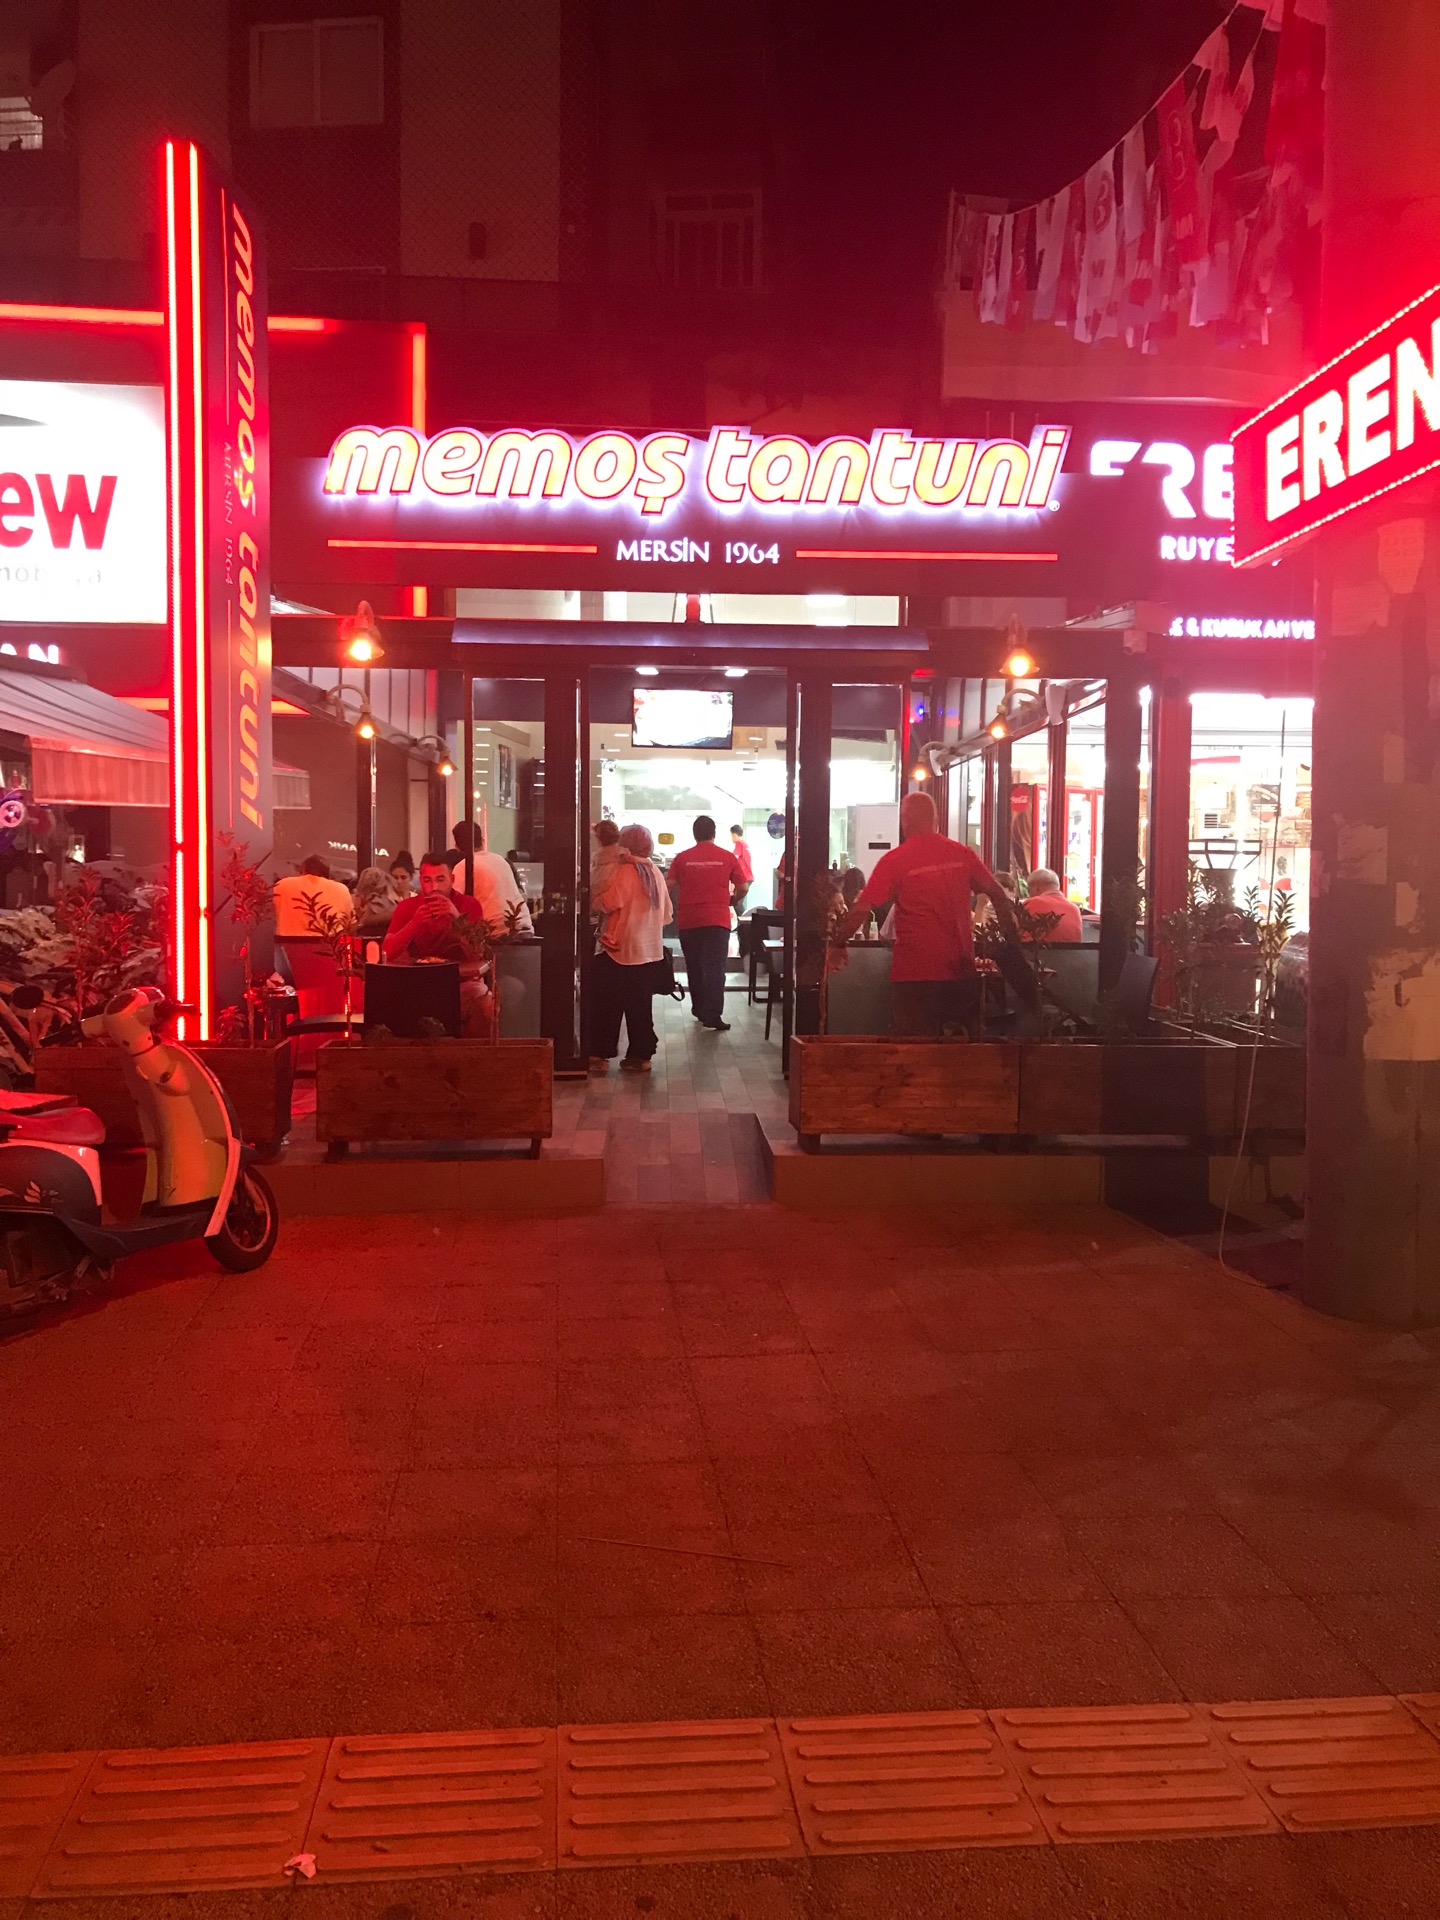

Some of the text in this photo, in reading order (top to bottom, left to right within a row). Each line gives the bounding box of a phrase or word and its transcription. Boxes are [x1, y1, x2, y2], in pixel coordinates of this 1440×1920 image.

[1266, 317, 1440, 522] EREN
[323, 427, 1068, 515] memoş tantuni
[616, 537, 780, 564] MERSİN 1964
